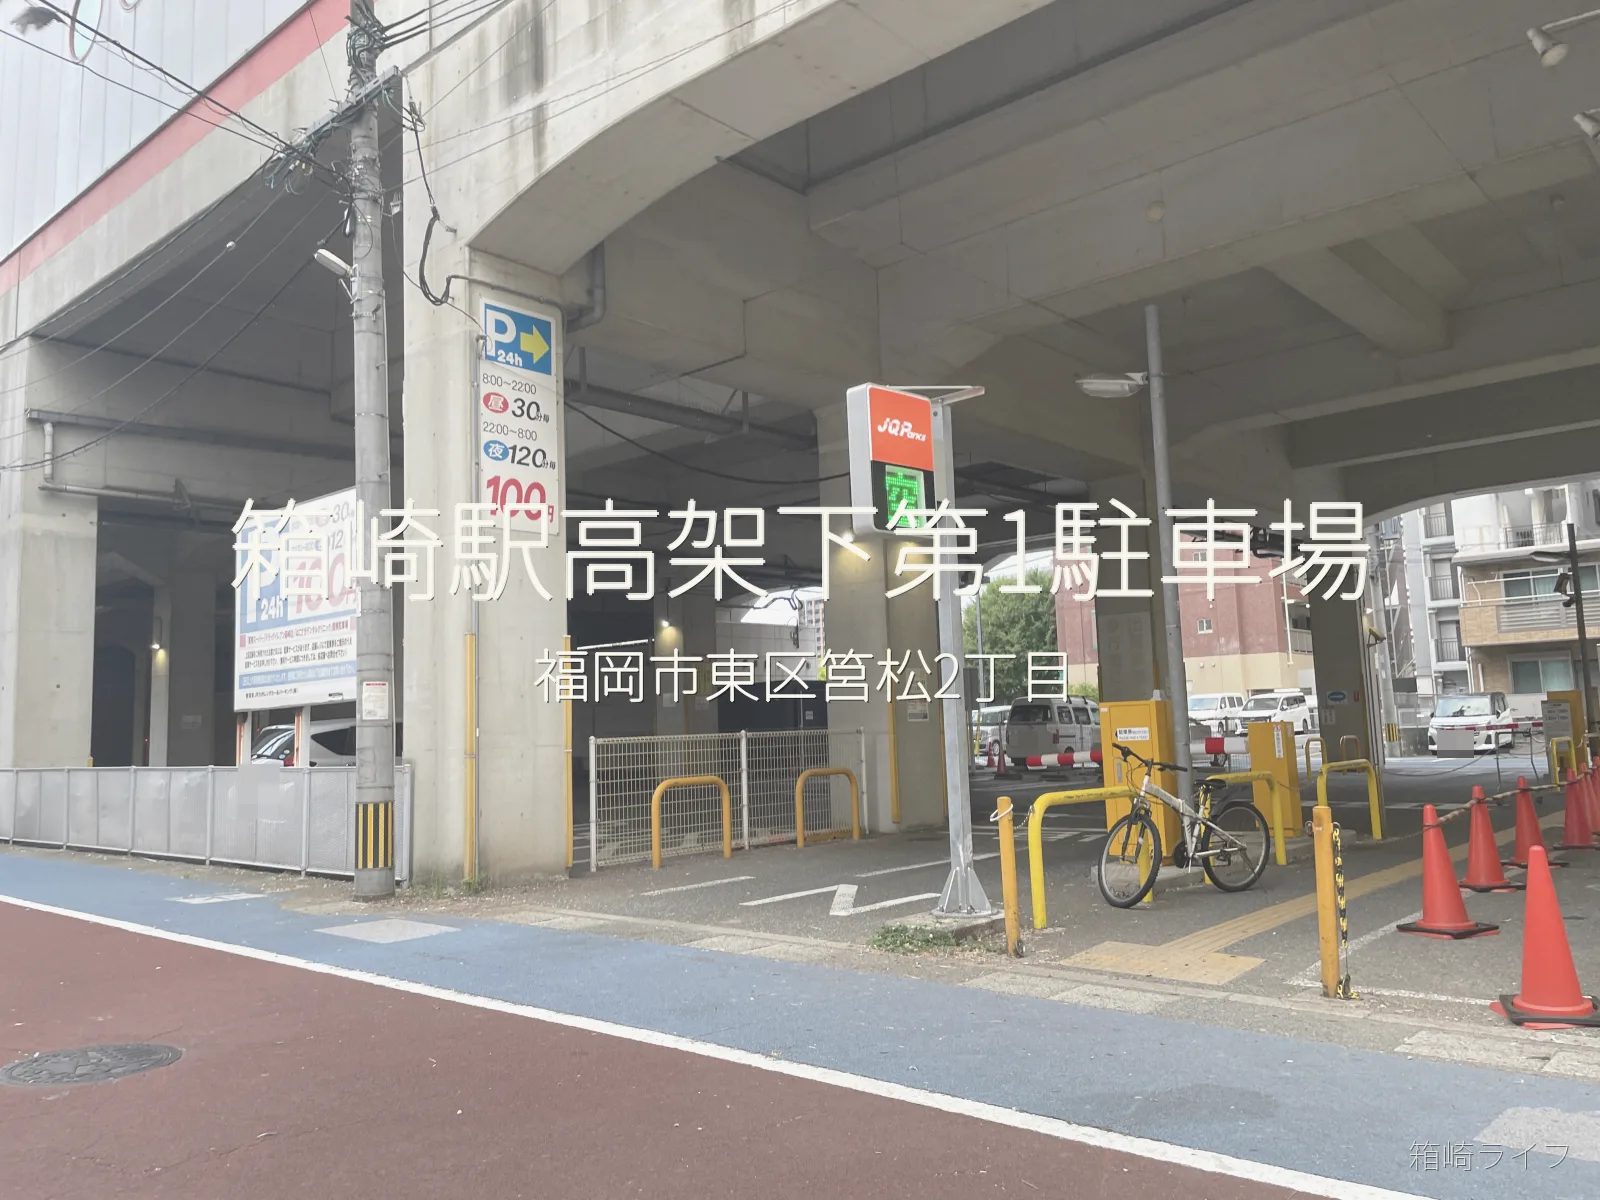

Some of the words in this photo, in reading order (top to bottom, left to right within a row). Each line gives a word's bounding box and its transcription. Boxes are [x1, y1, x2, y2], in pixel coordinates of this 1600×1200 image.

[486, 308, 517, 356] P
[497, 349, 523, 367] 24h
[488, 442, 505, 458] 夜
[260, 596, 284, 621] 24h
